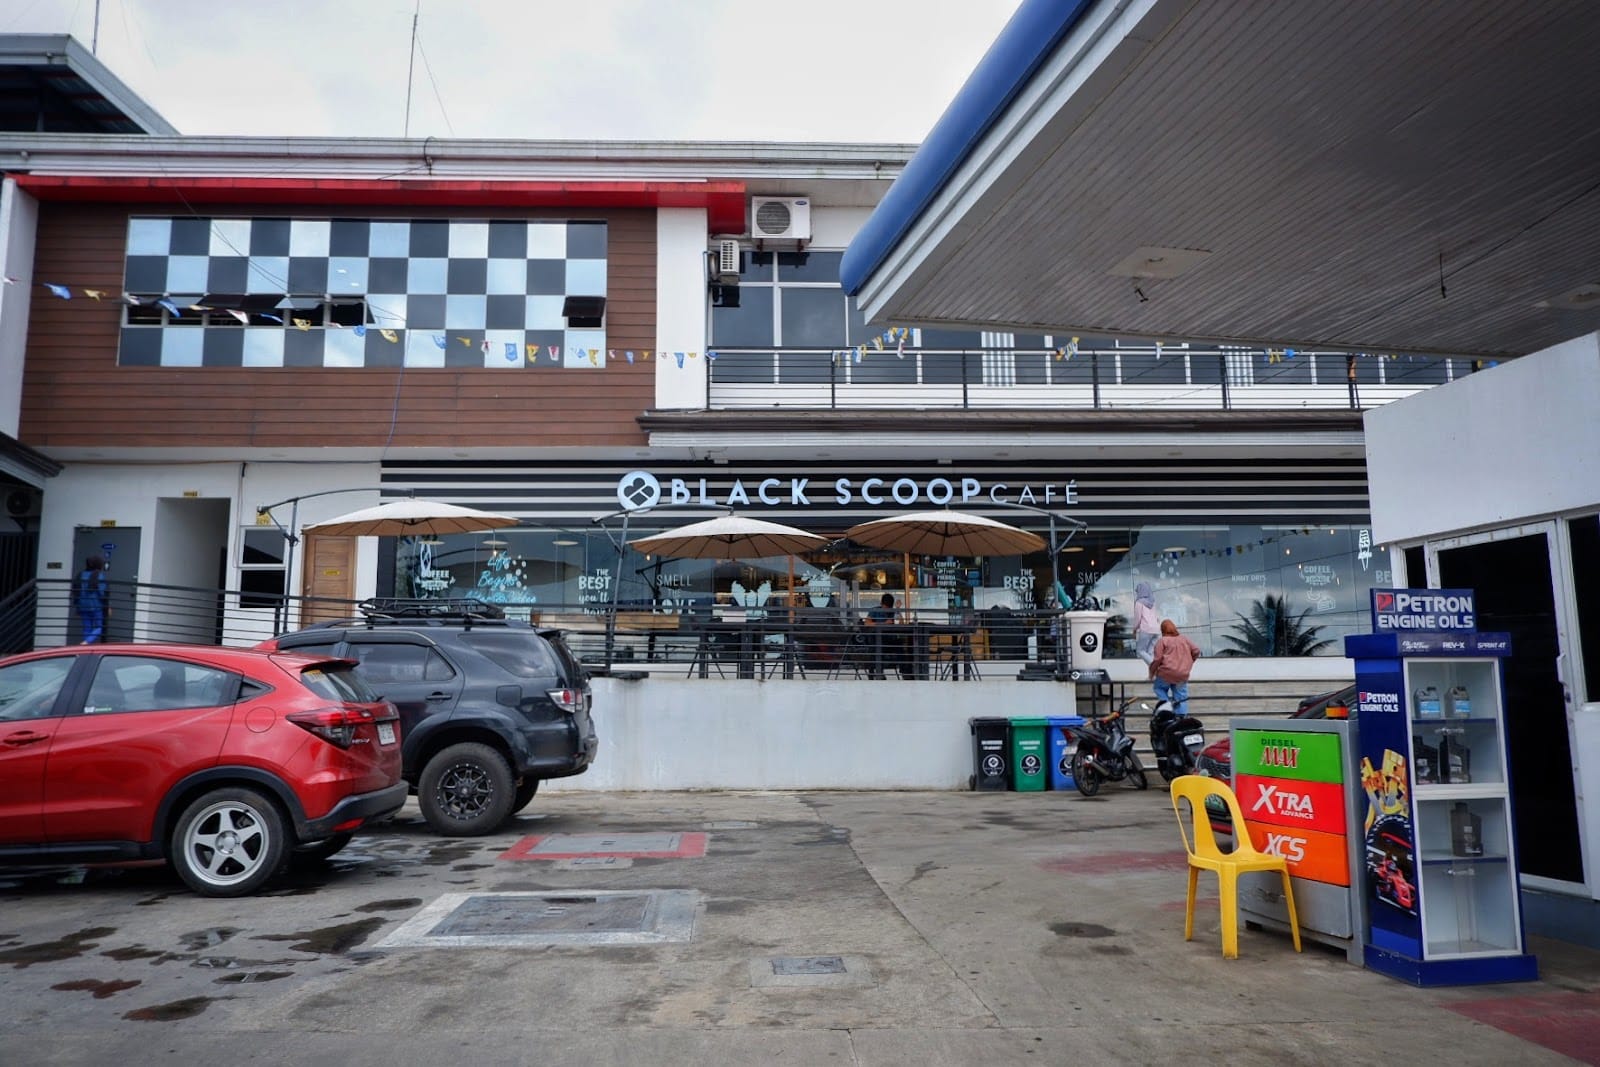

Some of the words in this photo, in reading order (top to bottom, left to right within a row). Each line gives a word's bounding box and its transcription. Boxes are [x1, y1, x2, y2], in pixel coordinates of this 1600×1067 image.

[671, 478, 811, 506] BLACK
[836, 478, 982, 505] SCOOP
[989, 479, 1080, 505] CAFÉ
[578, 576, 612, 589] BEST
[656, 574, 692, 587] SMELL
[1003, 575, 1036, 590] BEST
[1396, 593, 1474, 613] PETRON
[1377, 614, 1436, 629] ENGINE
[1438, 615, 1475, 629] OILS
[1366, 693, 1398, 703] PETRON
[1360, 703, 1383, 712] ENGINE
[1383, 704, 1399, 712] OILS
[1261, 738, 1297, 747] DIESEL
[1251, 783, 1314, 815] XTRA
[1280, 809, 1315, 820] ADVANCE
[1264, 833, 1307, 862] XCS
